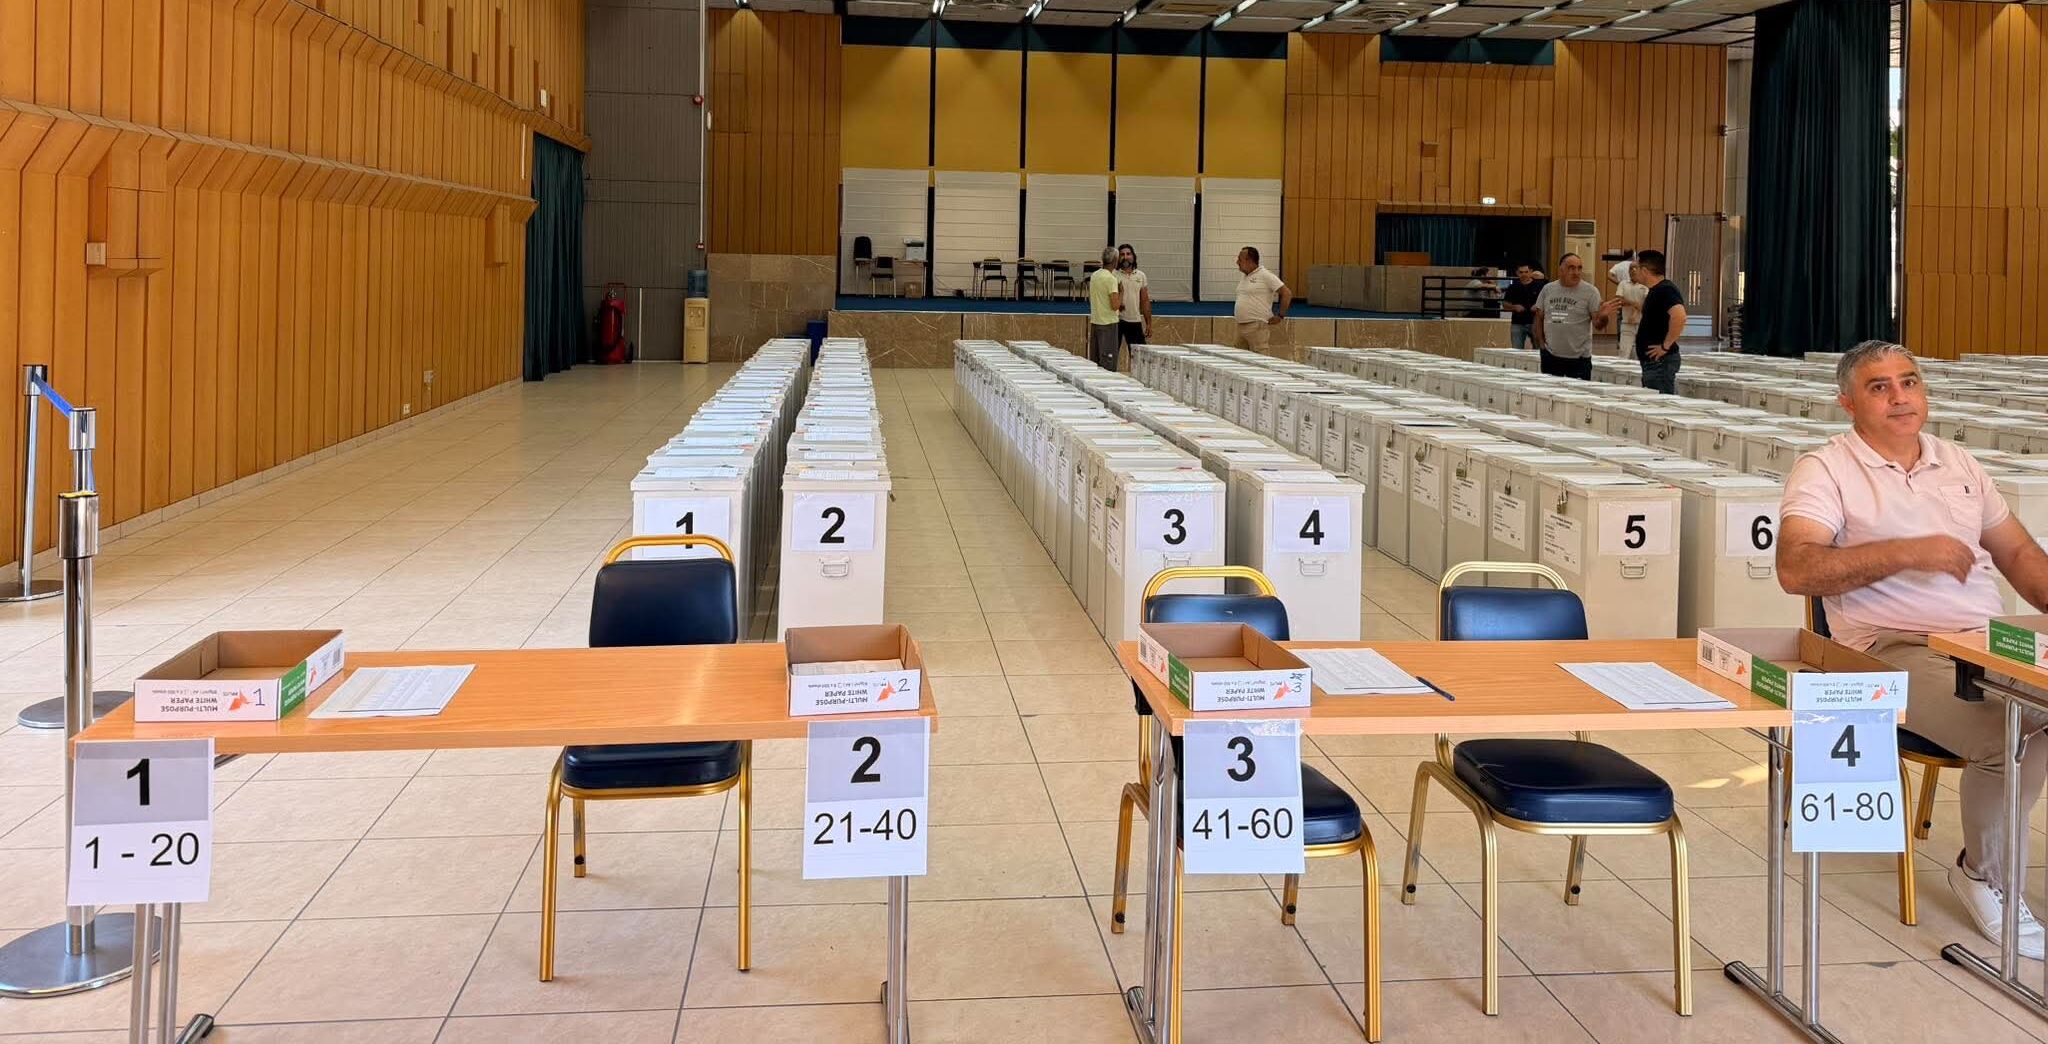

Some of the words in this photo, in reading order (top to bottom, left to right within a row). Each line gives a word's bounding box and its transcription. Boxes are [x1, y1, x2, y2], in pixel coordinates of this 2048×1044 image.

[675, 511, 694, 549] 1
[820, 507, 845, 544] 2
[1163, 508, 1187, 545] 3
[1299, 509, 1325, 545] 4
[1624, 514, 1647, 549] 5
[1751, 515, 1773, 550] 6
[253, 688, 266, 706] 1
[815, 697, 868, 706] MULTI-PURPOSE
[847, 689, 868, 697] WHITE
[898, 678, 911, 692] 2
[1889, 680, 1899, 695] 4
[161, 705, 218, 713] MULTI-PURPOSE
[850, 736, 881, 783] 2
[1227, 736, 1256, 782] 3
[1830, 724, 1861, 767] 4
[126, 758, 150, 806] 1
[1192, 807, 1293, 840] 41-60
[1801, 791, 1894, 822] 61-80
[813, 808, 917, 845] 21-40
[85, 835, 99, 869] 1
[150, 832, 200, 866] 20
